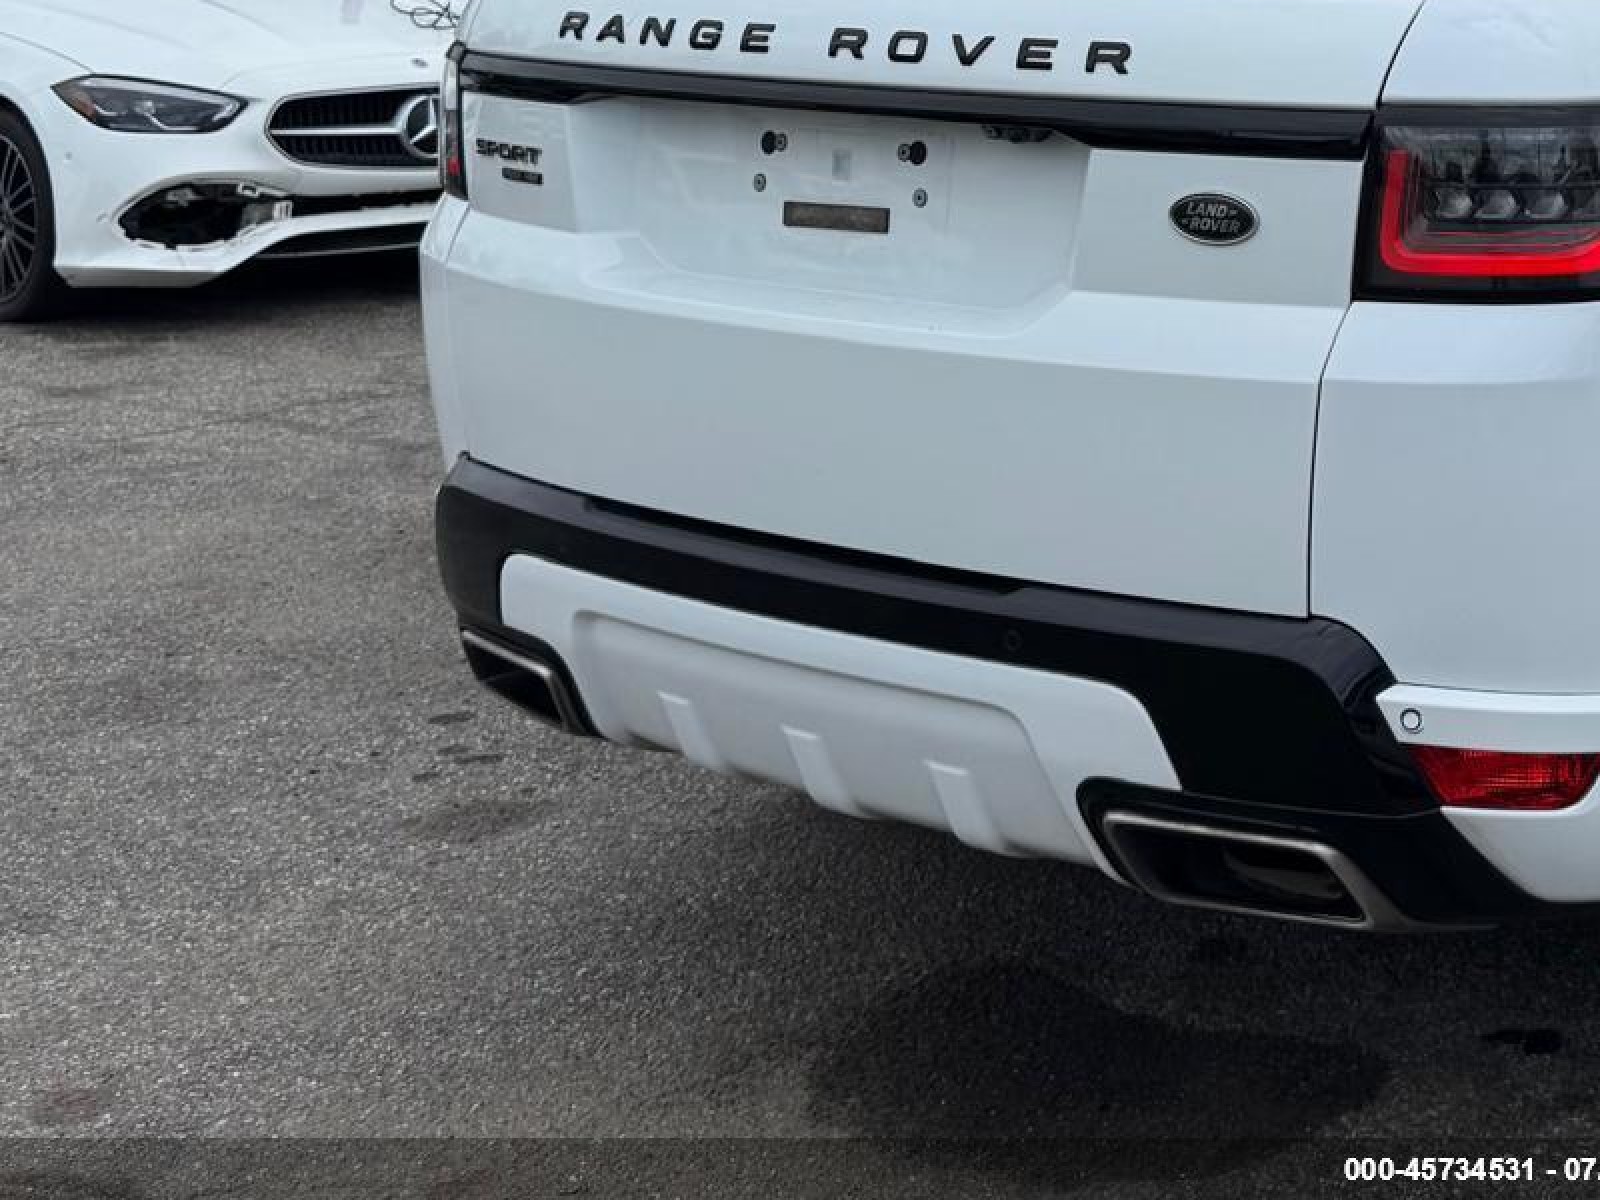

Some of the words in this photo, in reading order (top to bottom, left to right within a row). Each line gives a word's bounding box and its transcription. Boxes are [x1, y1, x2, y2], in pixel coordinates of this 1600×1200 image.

[559, 11, 777, 53] RANGE
[828, 27, 1131, 75] ROVER
[475, 137, 542, 165] SPORT
[1186, 201, 1228, 217] LAND
